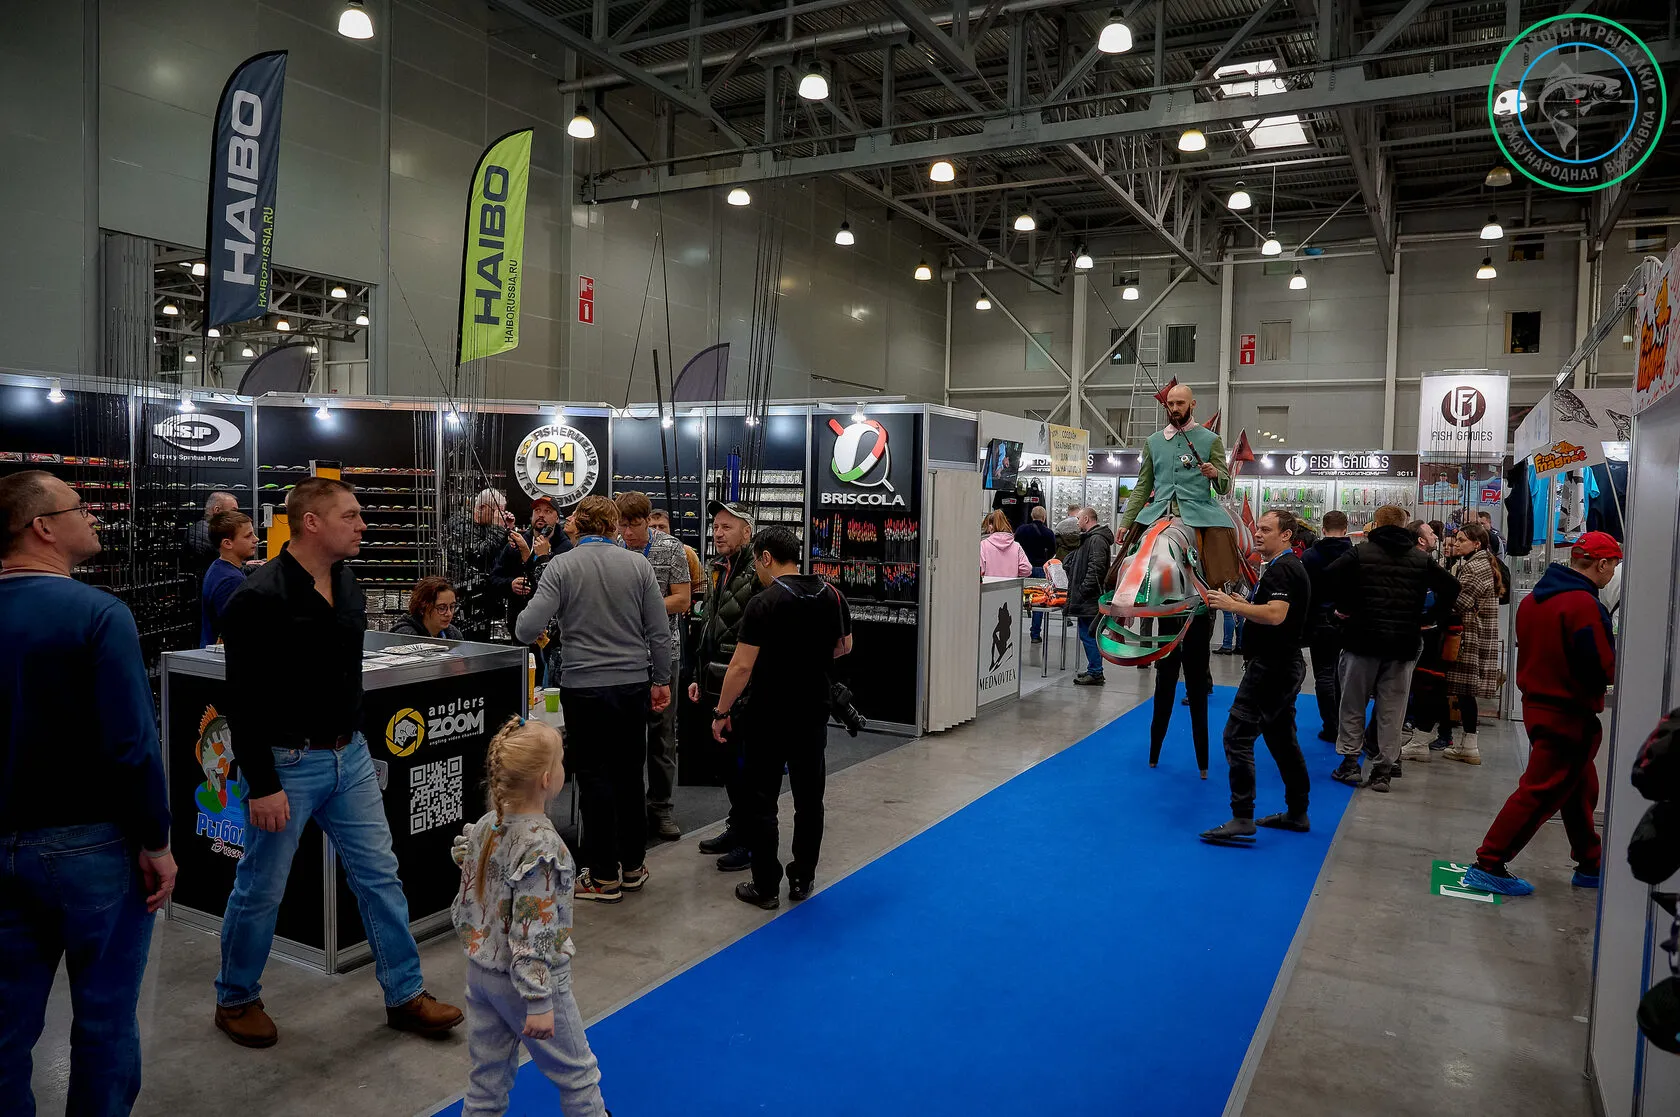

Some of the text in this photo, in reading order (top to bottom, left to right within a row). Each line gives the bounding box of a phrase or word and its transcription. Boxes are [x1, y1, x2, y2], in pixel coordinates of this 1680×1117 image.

[224, 90, 262, 286] HAIBO
[474, 165, 509, 326] HAIBO
[505, 259, 518, 343] HAIBORUSSIA.RU
[1432, 431, 1493, 441] FISH GAMES
[517, 427, 597, 505] FISHERMEN'S HAPPINE AS IT IS
[536, 441, 574, 485] 21
[1310, 455, 1339, 468] FISH
[821, 493, 905, 506] BRISCOLA
[428, 697, 484, 716] anglers
[428, 709, 484, 740] ZOOM
